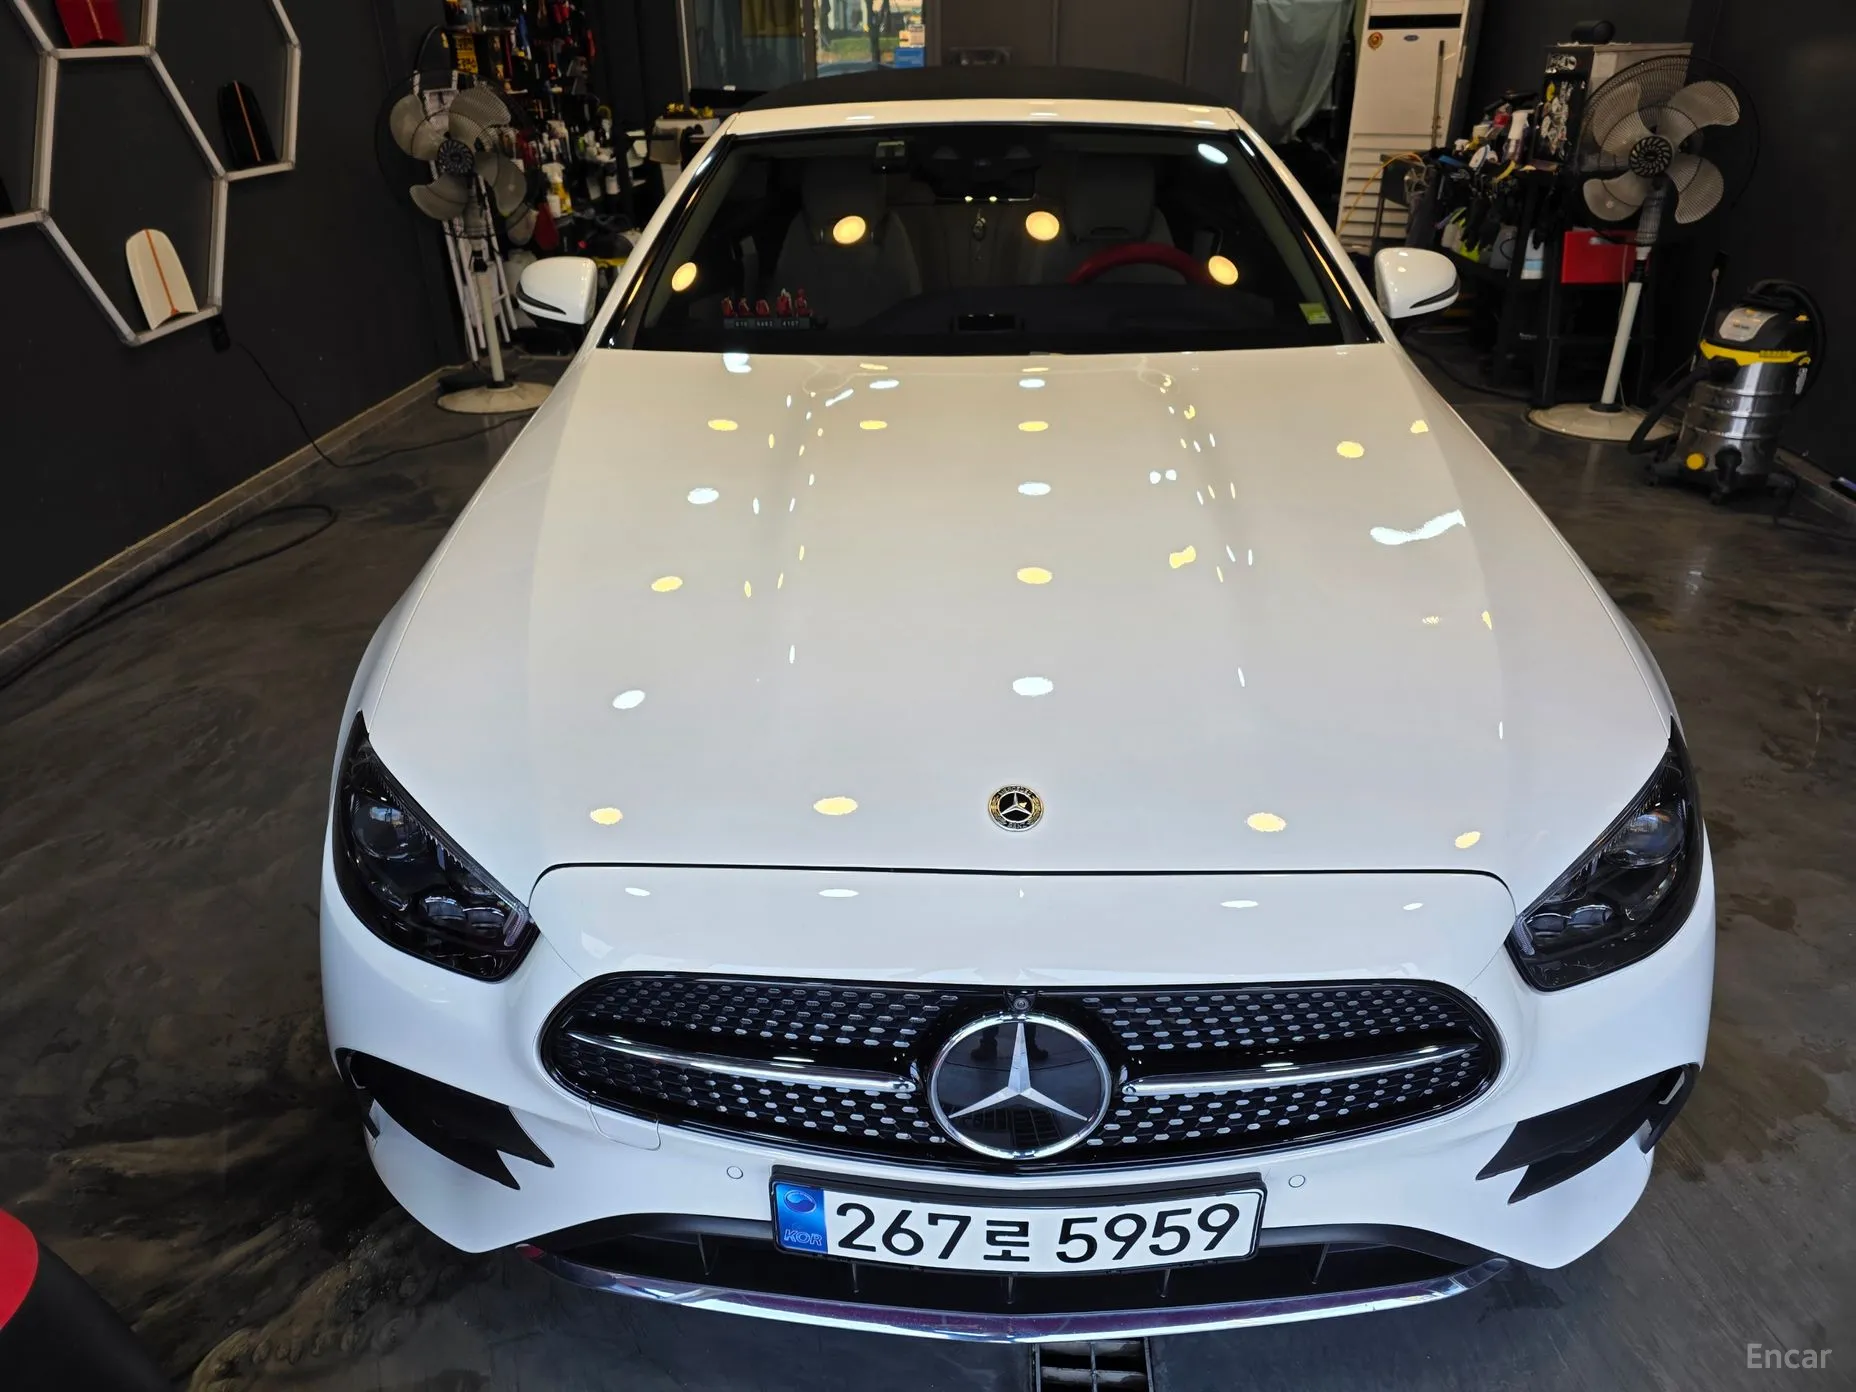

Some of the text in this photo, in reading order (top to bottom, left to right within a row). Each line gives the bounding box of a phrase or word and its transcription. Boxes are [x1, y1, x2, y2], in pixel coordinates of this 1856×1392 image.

[783, 1228, 823, 1247] KOR
[837, 1202, 1240, 1264] 267로 5959
